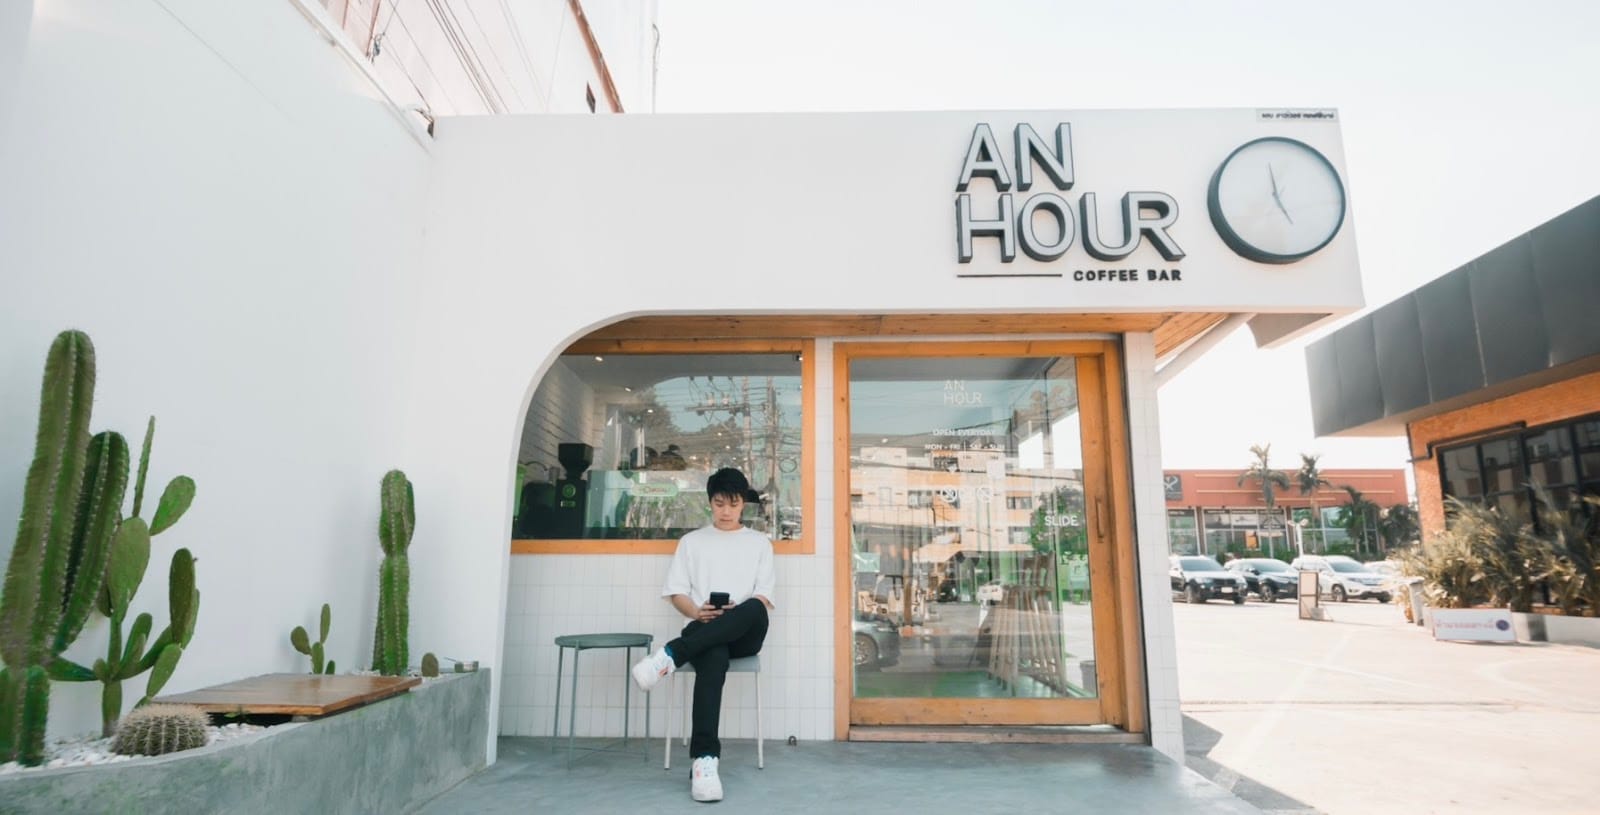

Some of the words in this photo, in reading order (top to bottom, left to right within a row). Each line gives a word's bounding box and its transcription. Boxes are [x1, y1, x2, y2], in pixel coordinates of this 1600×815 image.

[956, 122, 1075, 191] AN
[956, 191, 1186, 264] HOUR
[1073, 269, 1139, 282] COFFEE
[1147, 269, 1182, 281] BAR
[944, 379, 966, 391] AN
[944, 391, 983, 405] HOUR
[932, 428, 956, 436] OPEN
[1044, 515, 1080, 527] SLIDE
